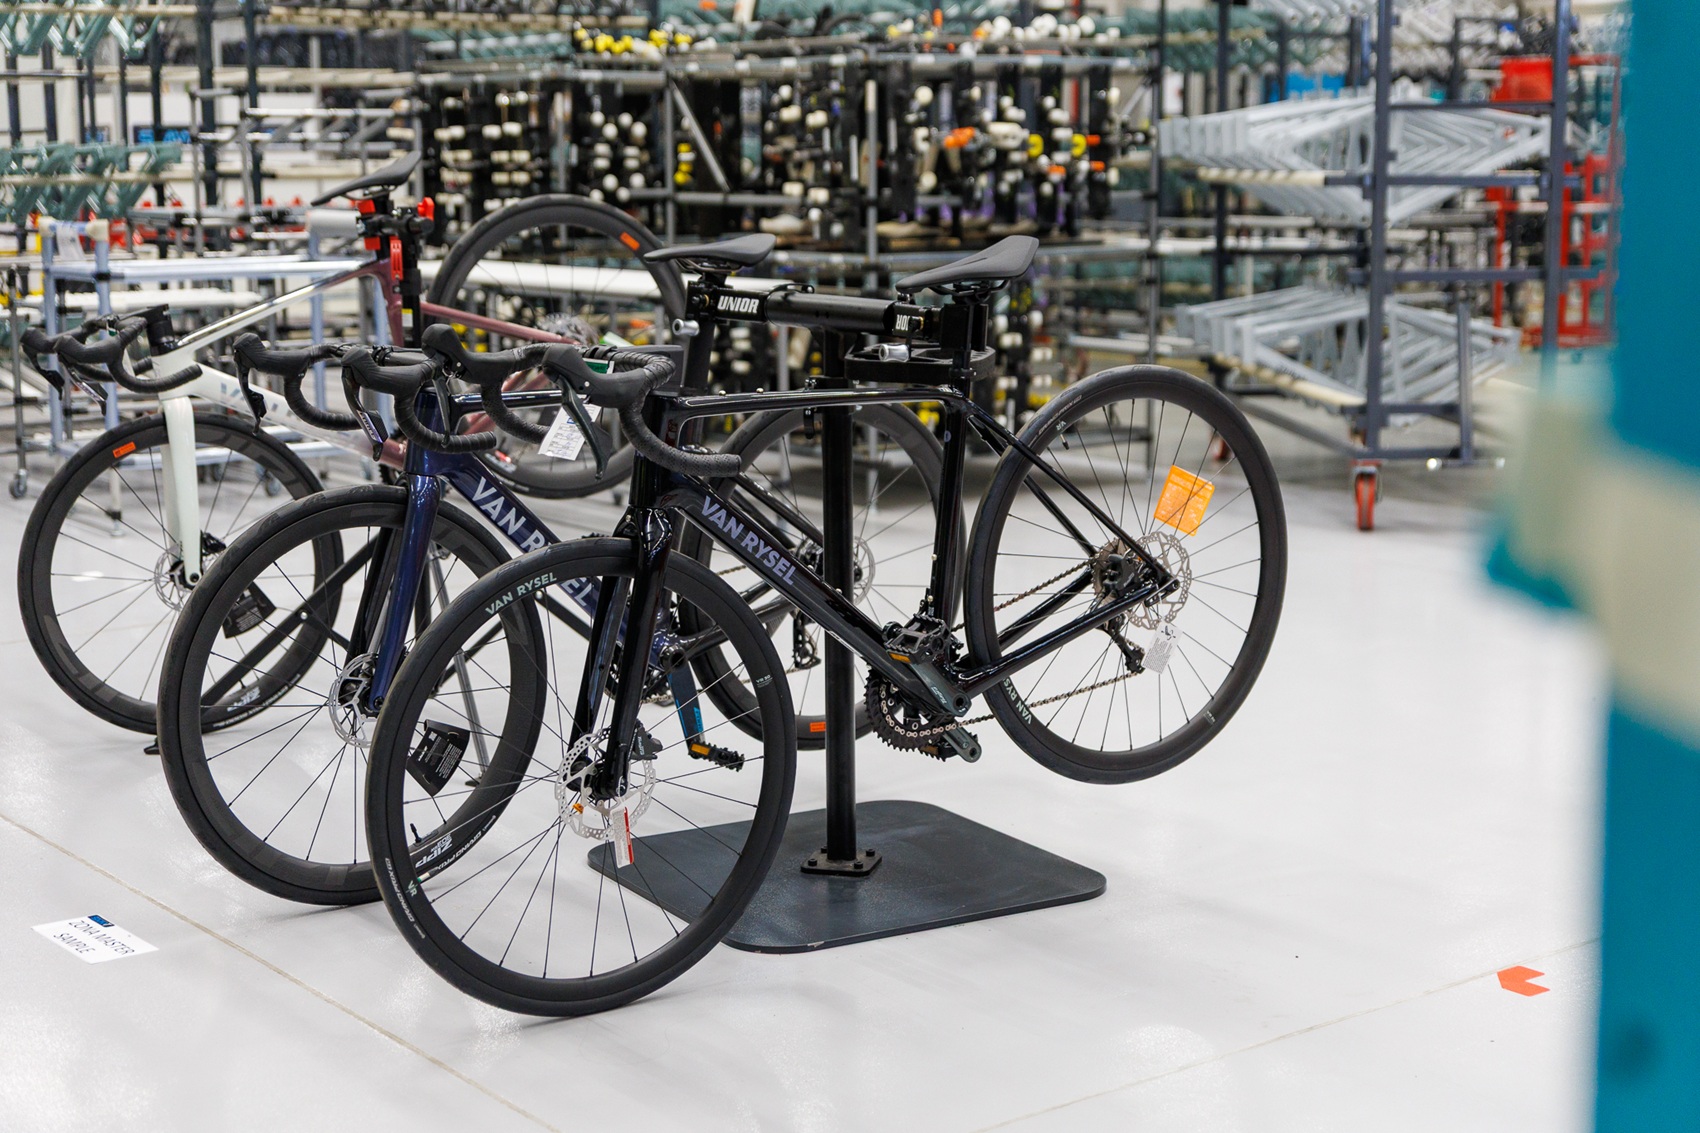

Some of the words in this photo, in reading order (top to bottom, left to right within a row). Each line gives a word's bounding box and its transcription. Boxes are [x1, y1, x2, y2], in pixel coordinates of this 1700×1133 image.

[717, 295, 760, 314] UNIOR
[472, 476, 526, 536] VAN
[701, 495, 744, 539] VAN
[741, 531, 796, 585] RYSEL
[485, 592, 513, 615] VAN
[517, 572, 557, 597] RYSEL
[1016, 701, 1032, 724] VAN
[53, 932, 95, 954] SAMPLE
[69, 920, 100, 936] ZONA
[95, 933, 135, 955] MASTER
